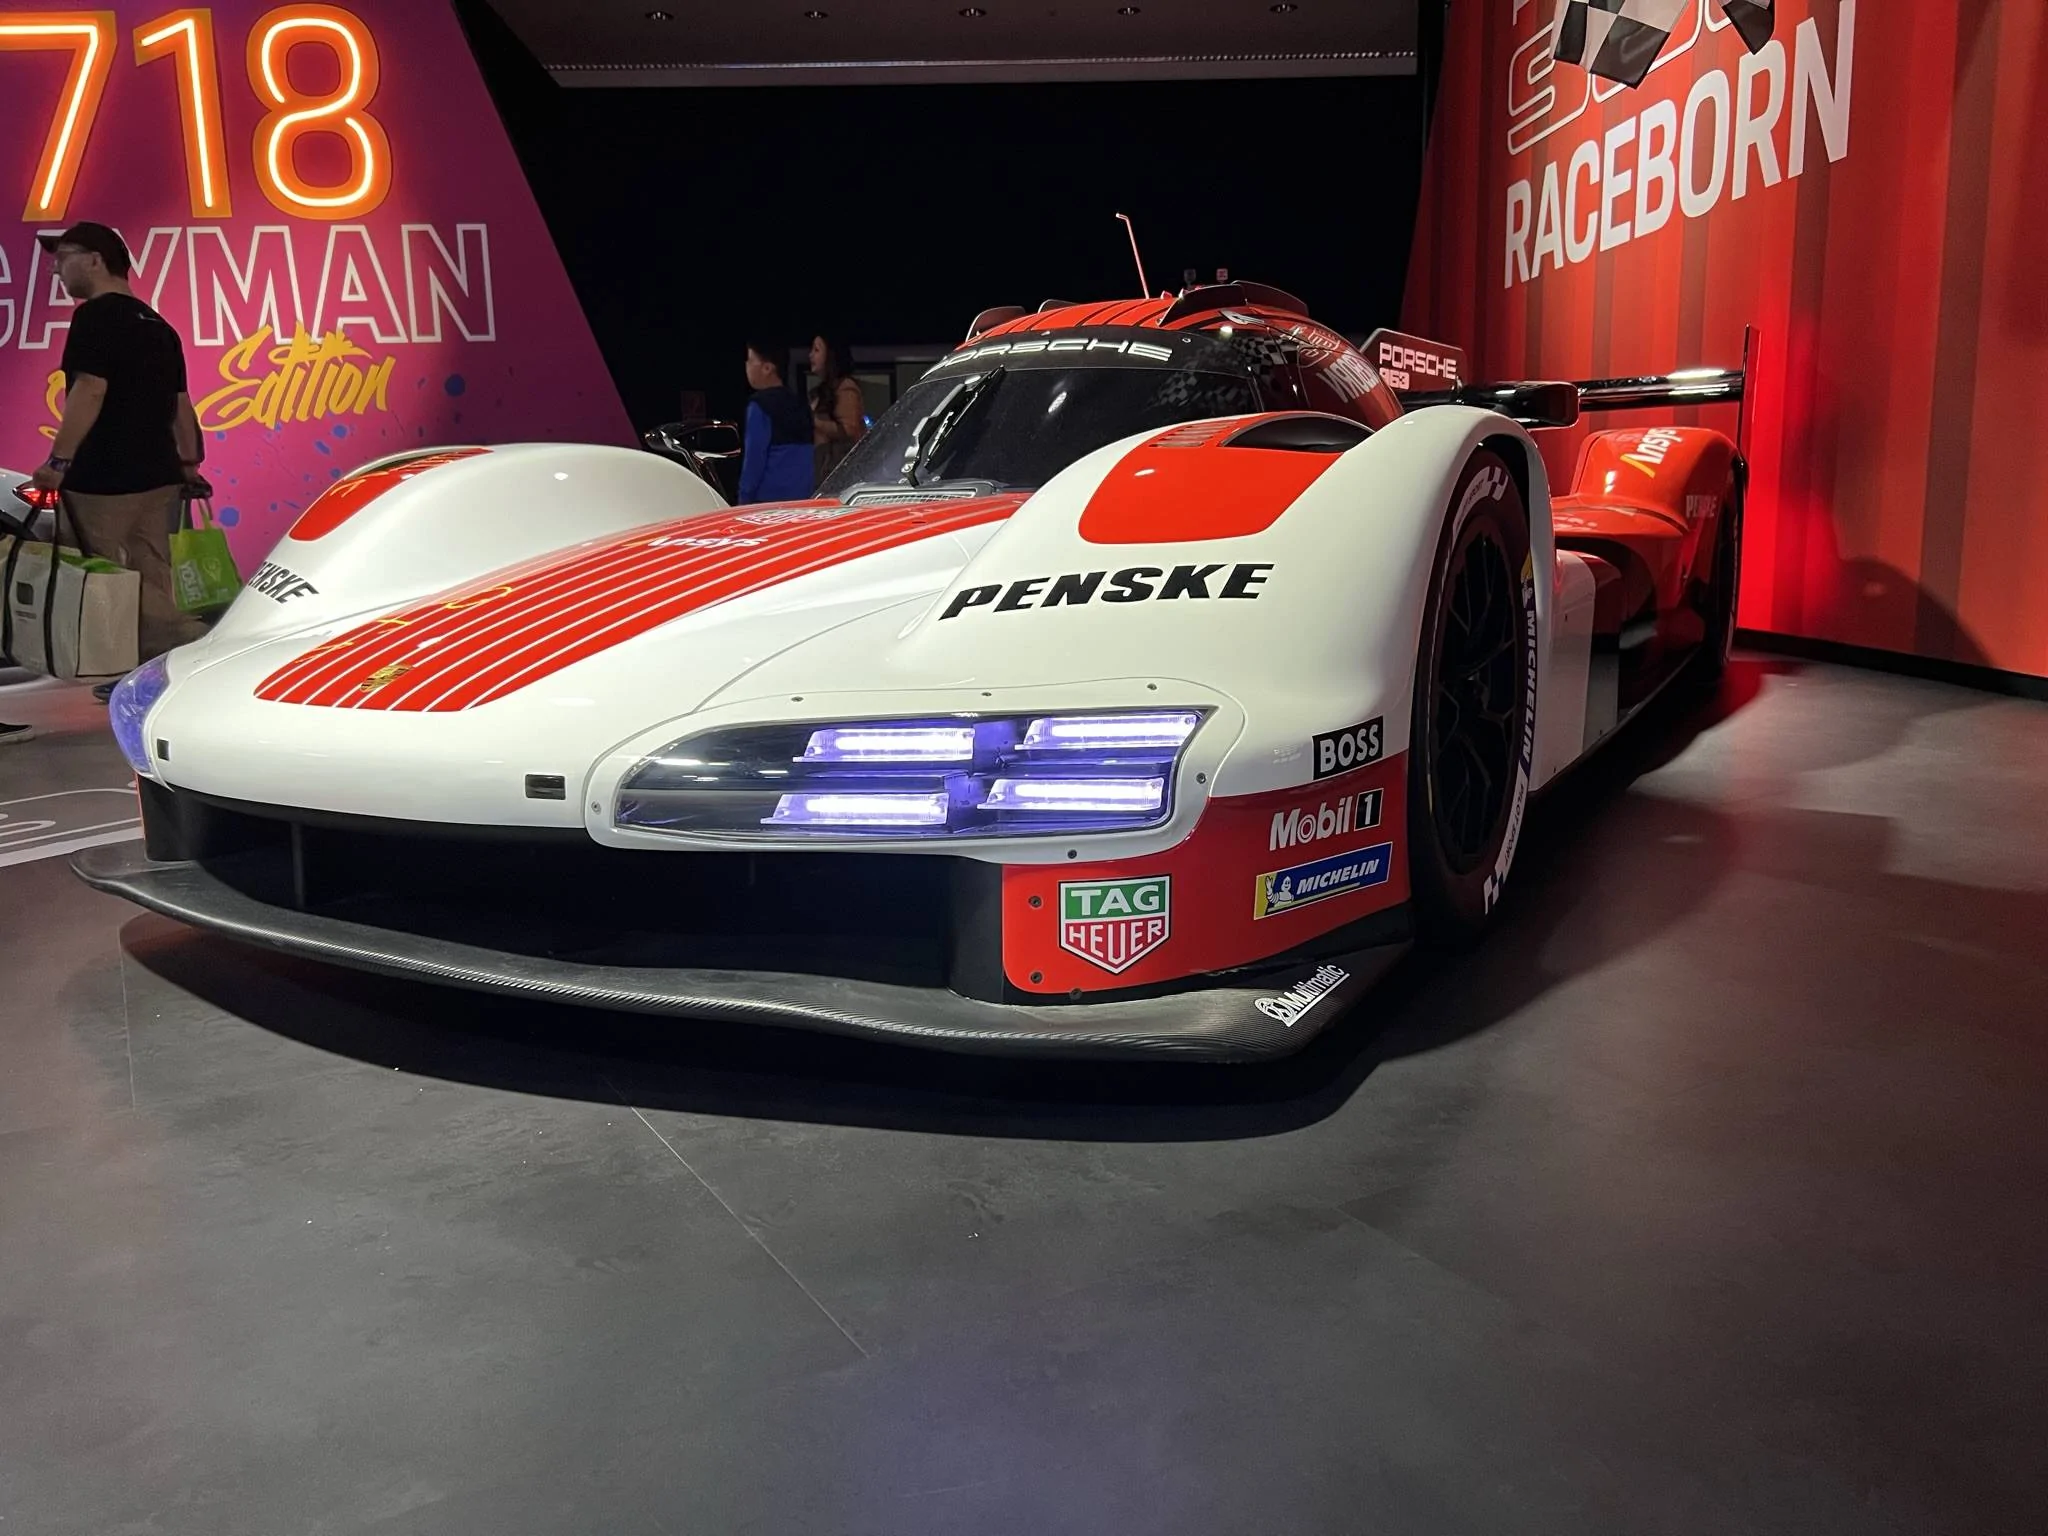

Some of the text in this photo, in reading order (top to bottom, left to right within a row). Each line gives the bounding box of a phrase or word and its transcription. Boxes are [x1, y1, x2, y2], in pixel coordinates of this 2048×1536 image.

[0, 4, 392, 221] 718
[1503, 0, 1856, 289] RACEBORN
[0, 223, 496, 350] AYMAN
[194, 320, 396, 431] Edition
[1378, 342, 1457, 380] PORSCHE
[1378, 366, 1410, 390] 963
[938, 563, 1276, 621] PENSKE
[1522, 610, 1536, 763] MICHELIN
[1319, 723, 1380, 773] BOSS
[1269, 795, 1354, 851] Mobil
[1070, 884, 1160, 916] TAG
[1296, 858, 1380, 895] MICHELIN
[1068, 919, 1162, 965] HEUER
[1277, 964, 1345, 1015] Multimatic
